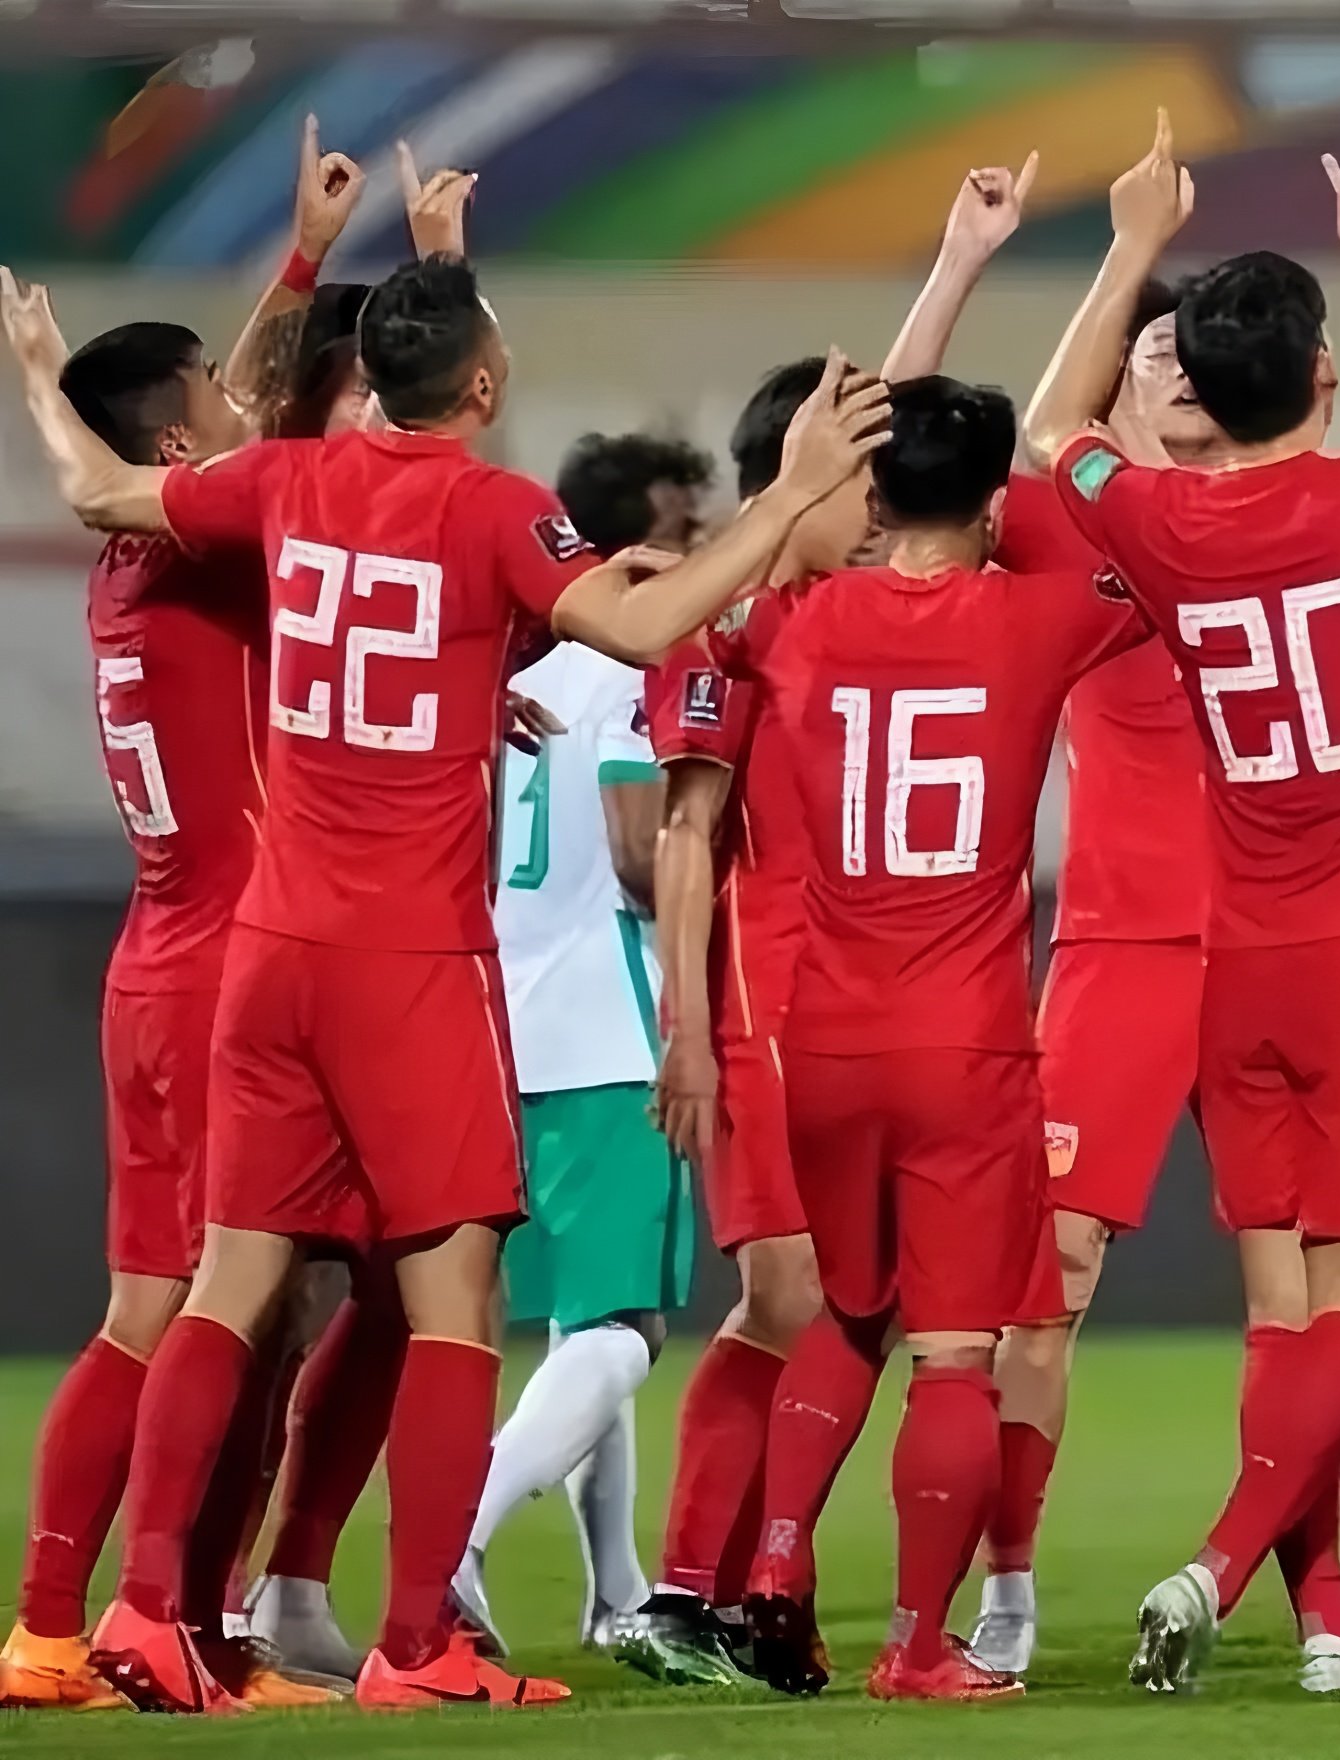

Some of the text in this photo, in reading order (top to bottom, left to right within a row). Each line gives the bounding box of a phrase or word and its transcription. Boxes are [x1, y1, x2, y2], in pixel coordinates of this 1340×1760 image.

[268, 534, 442, 752] 22
[97, 656, 180, 837] 5
[831, 687, 987, 878] 16
